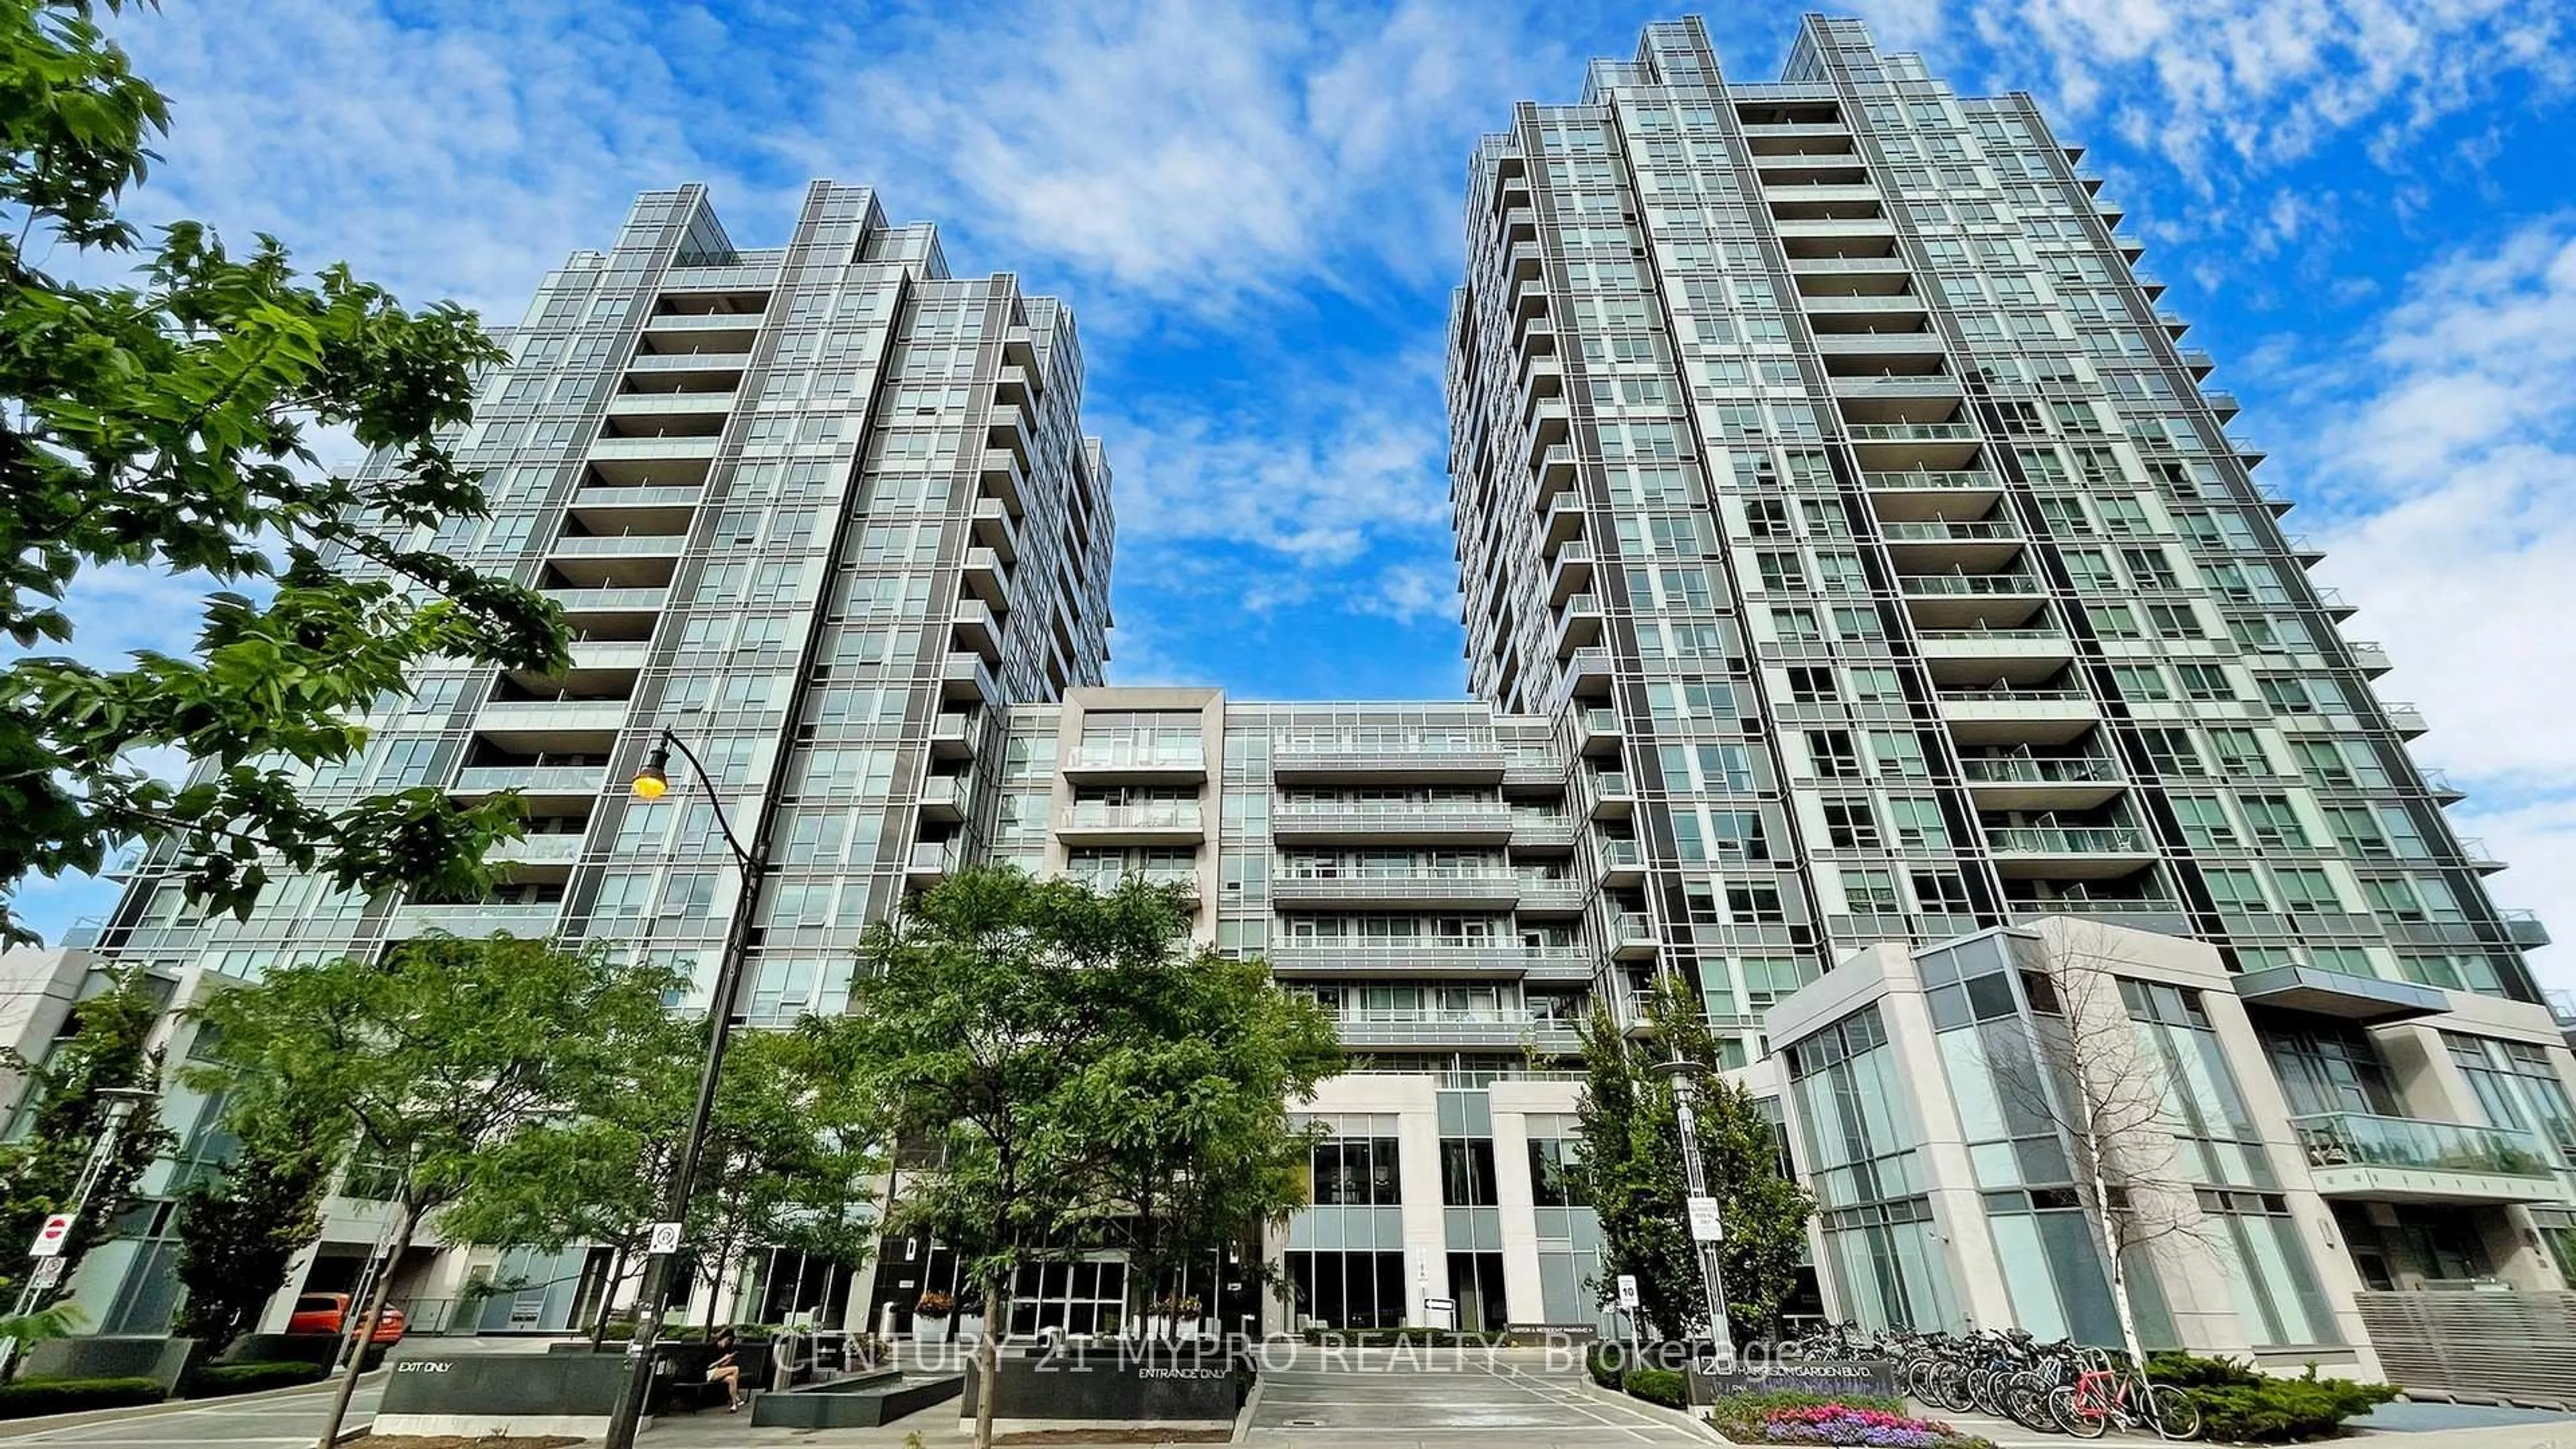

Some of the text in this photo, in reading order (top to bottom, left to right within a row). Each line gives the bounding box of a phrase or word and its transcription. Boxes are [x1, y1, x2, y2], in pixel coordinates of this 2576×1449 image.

[1623, 1287, 1634, 1296] 10
[398, 1362, 453, 1373] EXIT ONLY
[1737, 1366, 1794, 1376] HARRISON
[1795, 1366, 1841, 1376] GARDEN
[1842, 1367, 1873, 1377] BLVD.
[1139, 1368, 1228, 1379] ENTRANCE ONLY
